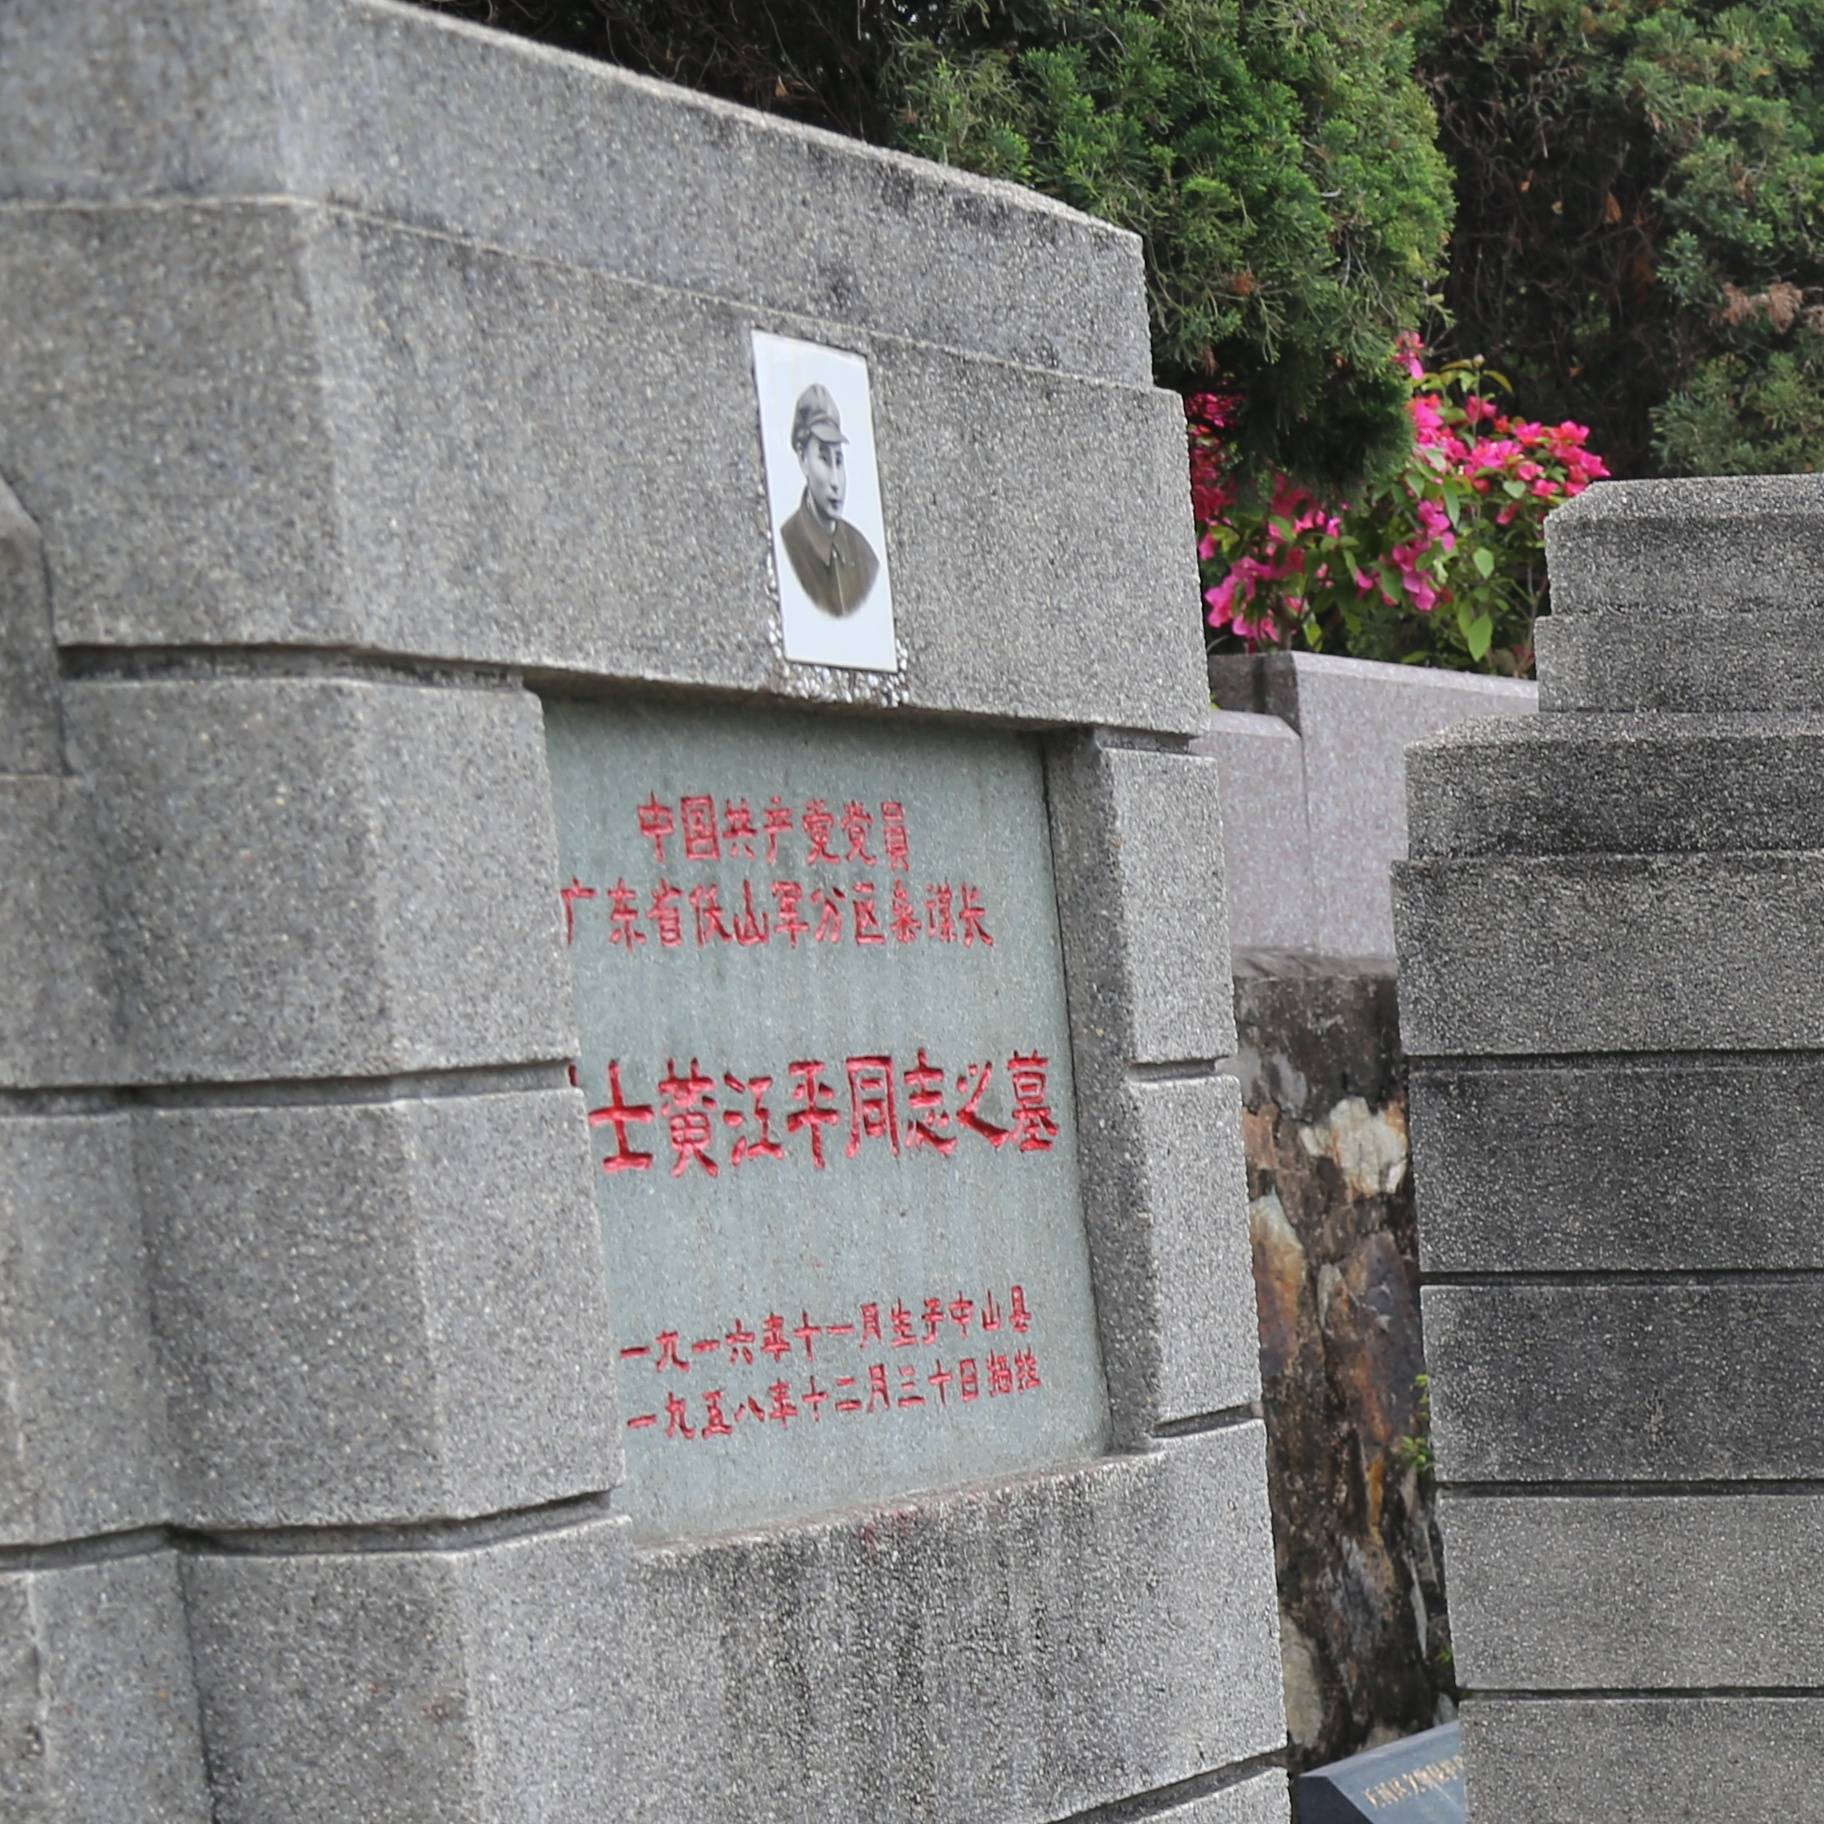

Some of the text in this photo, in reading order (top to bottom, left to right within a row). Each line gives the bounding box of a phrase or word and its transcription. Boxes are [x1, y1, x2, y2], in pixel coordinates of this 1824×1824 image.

[568, 1049, 1060, 1178] 士黄江平同志之墓
